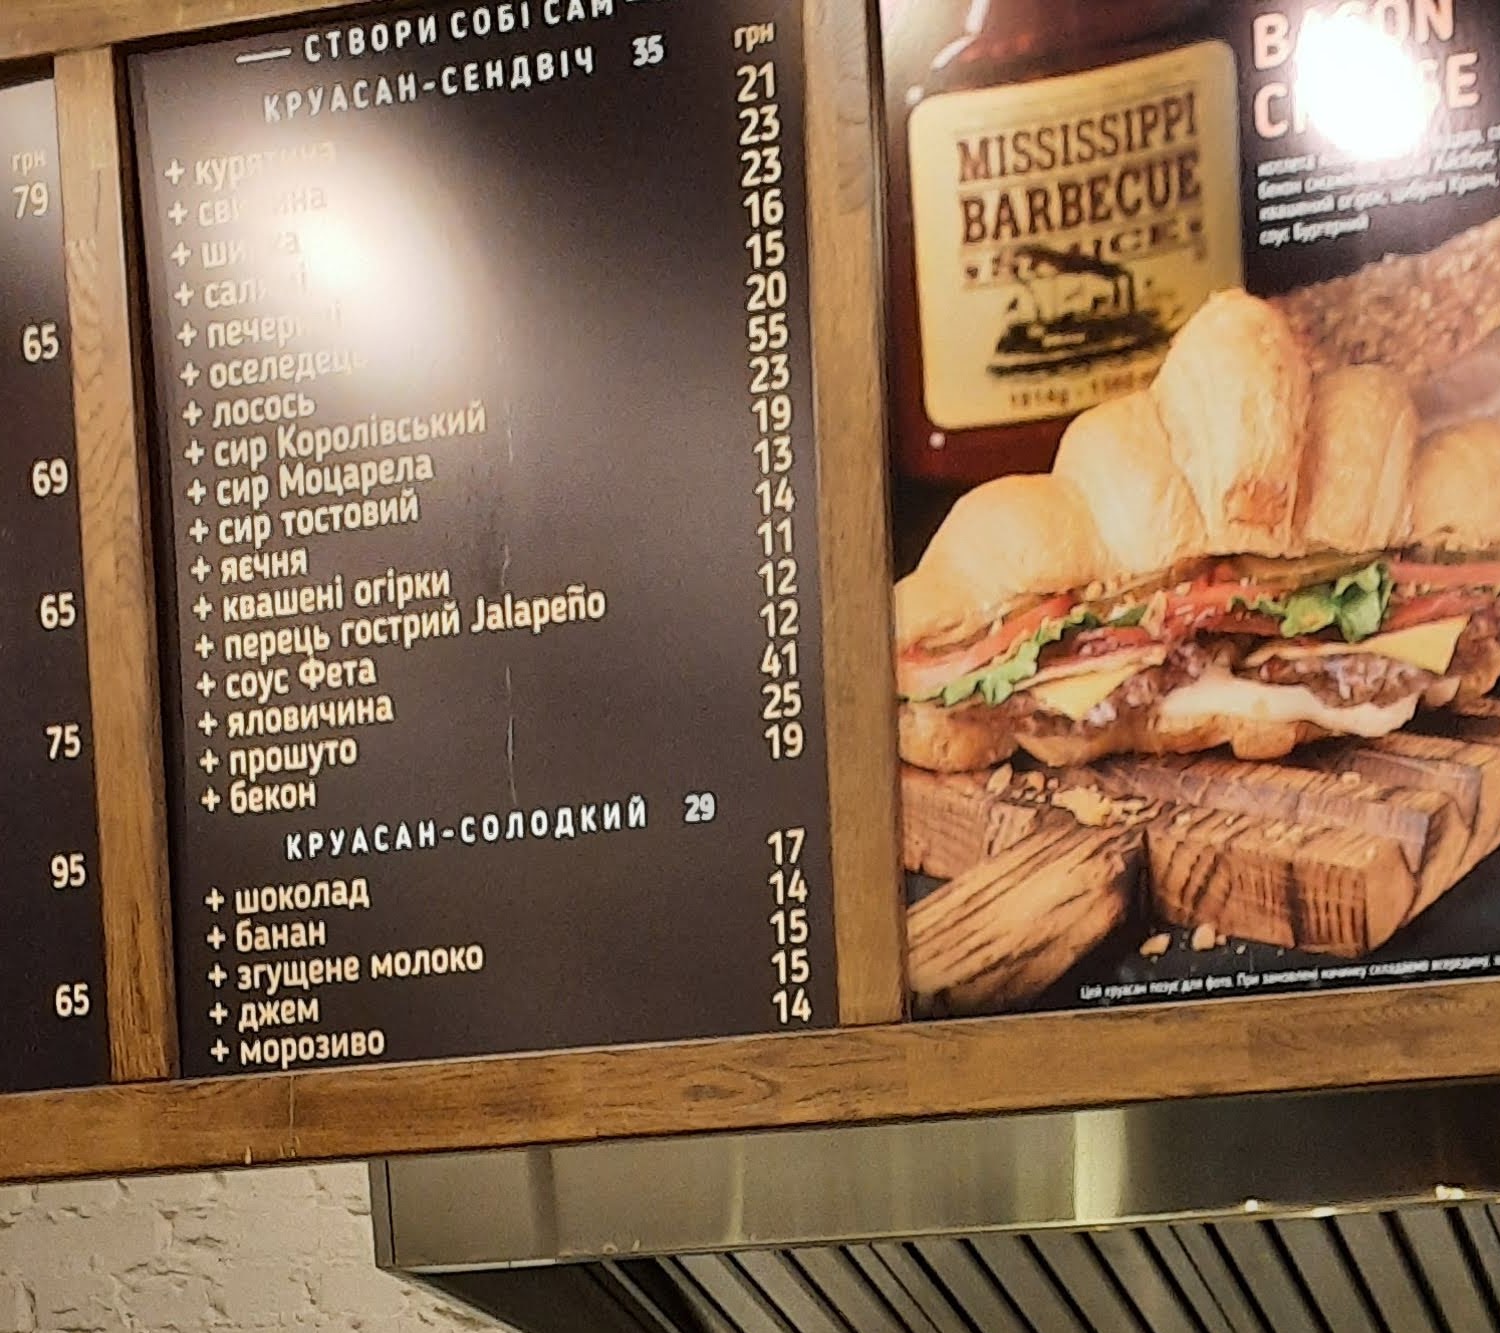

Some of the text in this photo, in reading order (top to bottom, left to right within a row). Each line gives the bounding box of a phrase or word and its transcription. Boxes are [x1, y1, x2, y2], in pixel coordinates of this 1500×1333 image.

[304, 11, 437, 64] СТВОРИ
[450, 0, 531, 41] СОБІ
[733, 22, 775, 52] грн
[263, 34, 665, 125] КРУАСАН-СЕНДВІЧ 35
[956, 92, 1198, 185] MISSISSIPPI
[960, 154, 1201, 247] BARBECUE
[22, 323, 60, 363] 65
[212, 393, 315, 429] лосось
[214, 400, 486, 472] сир Королівський
[32, 459, 69, 497] 69
[216, 453, 434, 510] сир Моцарела
[218, 488, 419, 549] сир тостовий
[221, 548, 307, 584] яєчня
[222, 568, 450, 623] квашені огірки
[224, 583, 607, 665] перець гострий Jalapeño
[225, 657, 377, 703] соус Фета
[227, 695, 395, 738] яловичина
[45, 724, 81, 759] 75
[229, 738, 358, 781] прошуто
[230, 780, 317, 815] бекон
[286, 792, 716, 860] КРУАСАН-СОЛОДКИЙ 29
[235, 877, 370, 915] шоколад
[236, 919, 326, 952] банан
[238, 944, 483, 994] згущене молоко
[239, 998, 319, 1032] джем
[239, 1029, 385, 1070] морозиво
